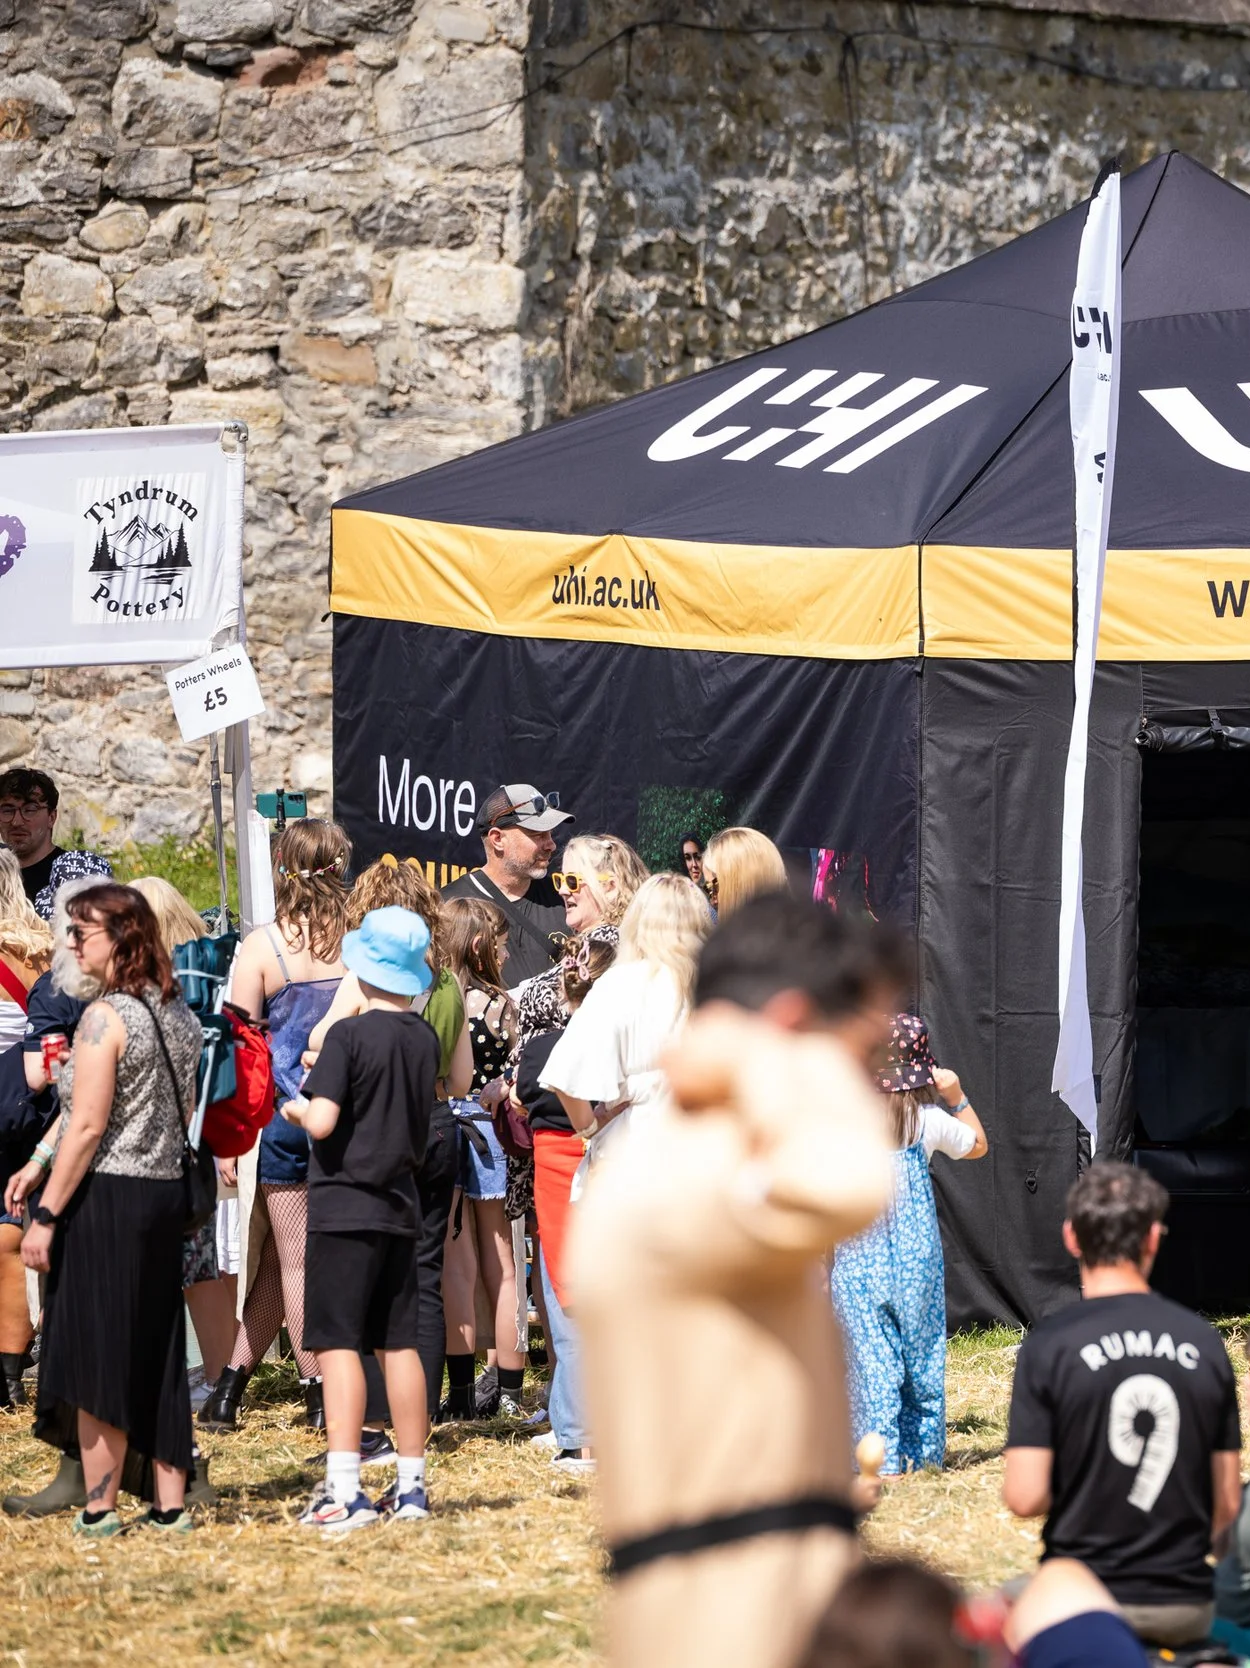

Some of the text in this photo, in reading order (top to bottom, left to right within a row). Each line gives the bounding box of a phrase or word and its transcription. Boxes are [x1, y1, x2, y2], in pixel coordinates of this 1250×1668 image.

[647, 366, 987, 474] UHI
[84, 480, 198, 524] Tyndrum
[90, 583, 184, 617] Pottery
[552, 564, 661, 611] uhi.ac.uk
[175, 658, 242, 691] Potters Wheels
[204, 686, 228, 712] £5
[378, 754, 476, 838] More
[1079, 1329, 1201, 1373] RUMAC
[1107, 1373, 1181, 1514] 9
